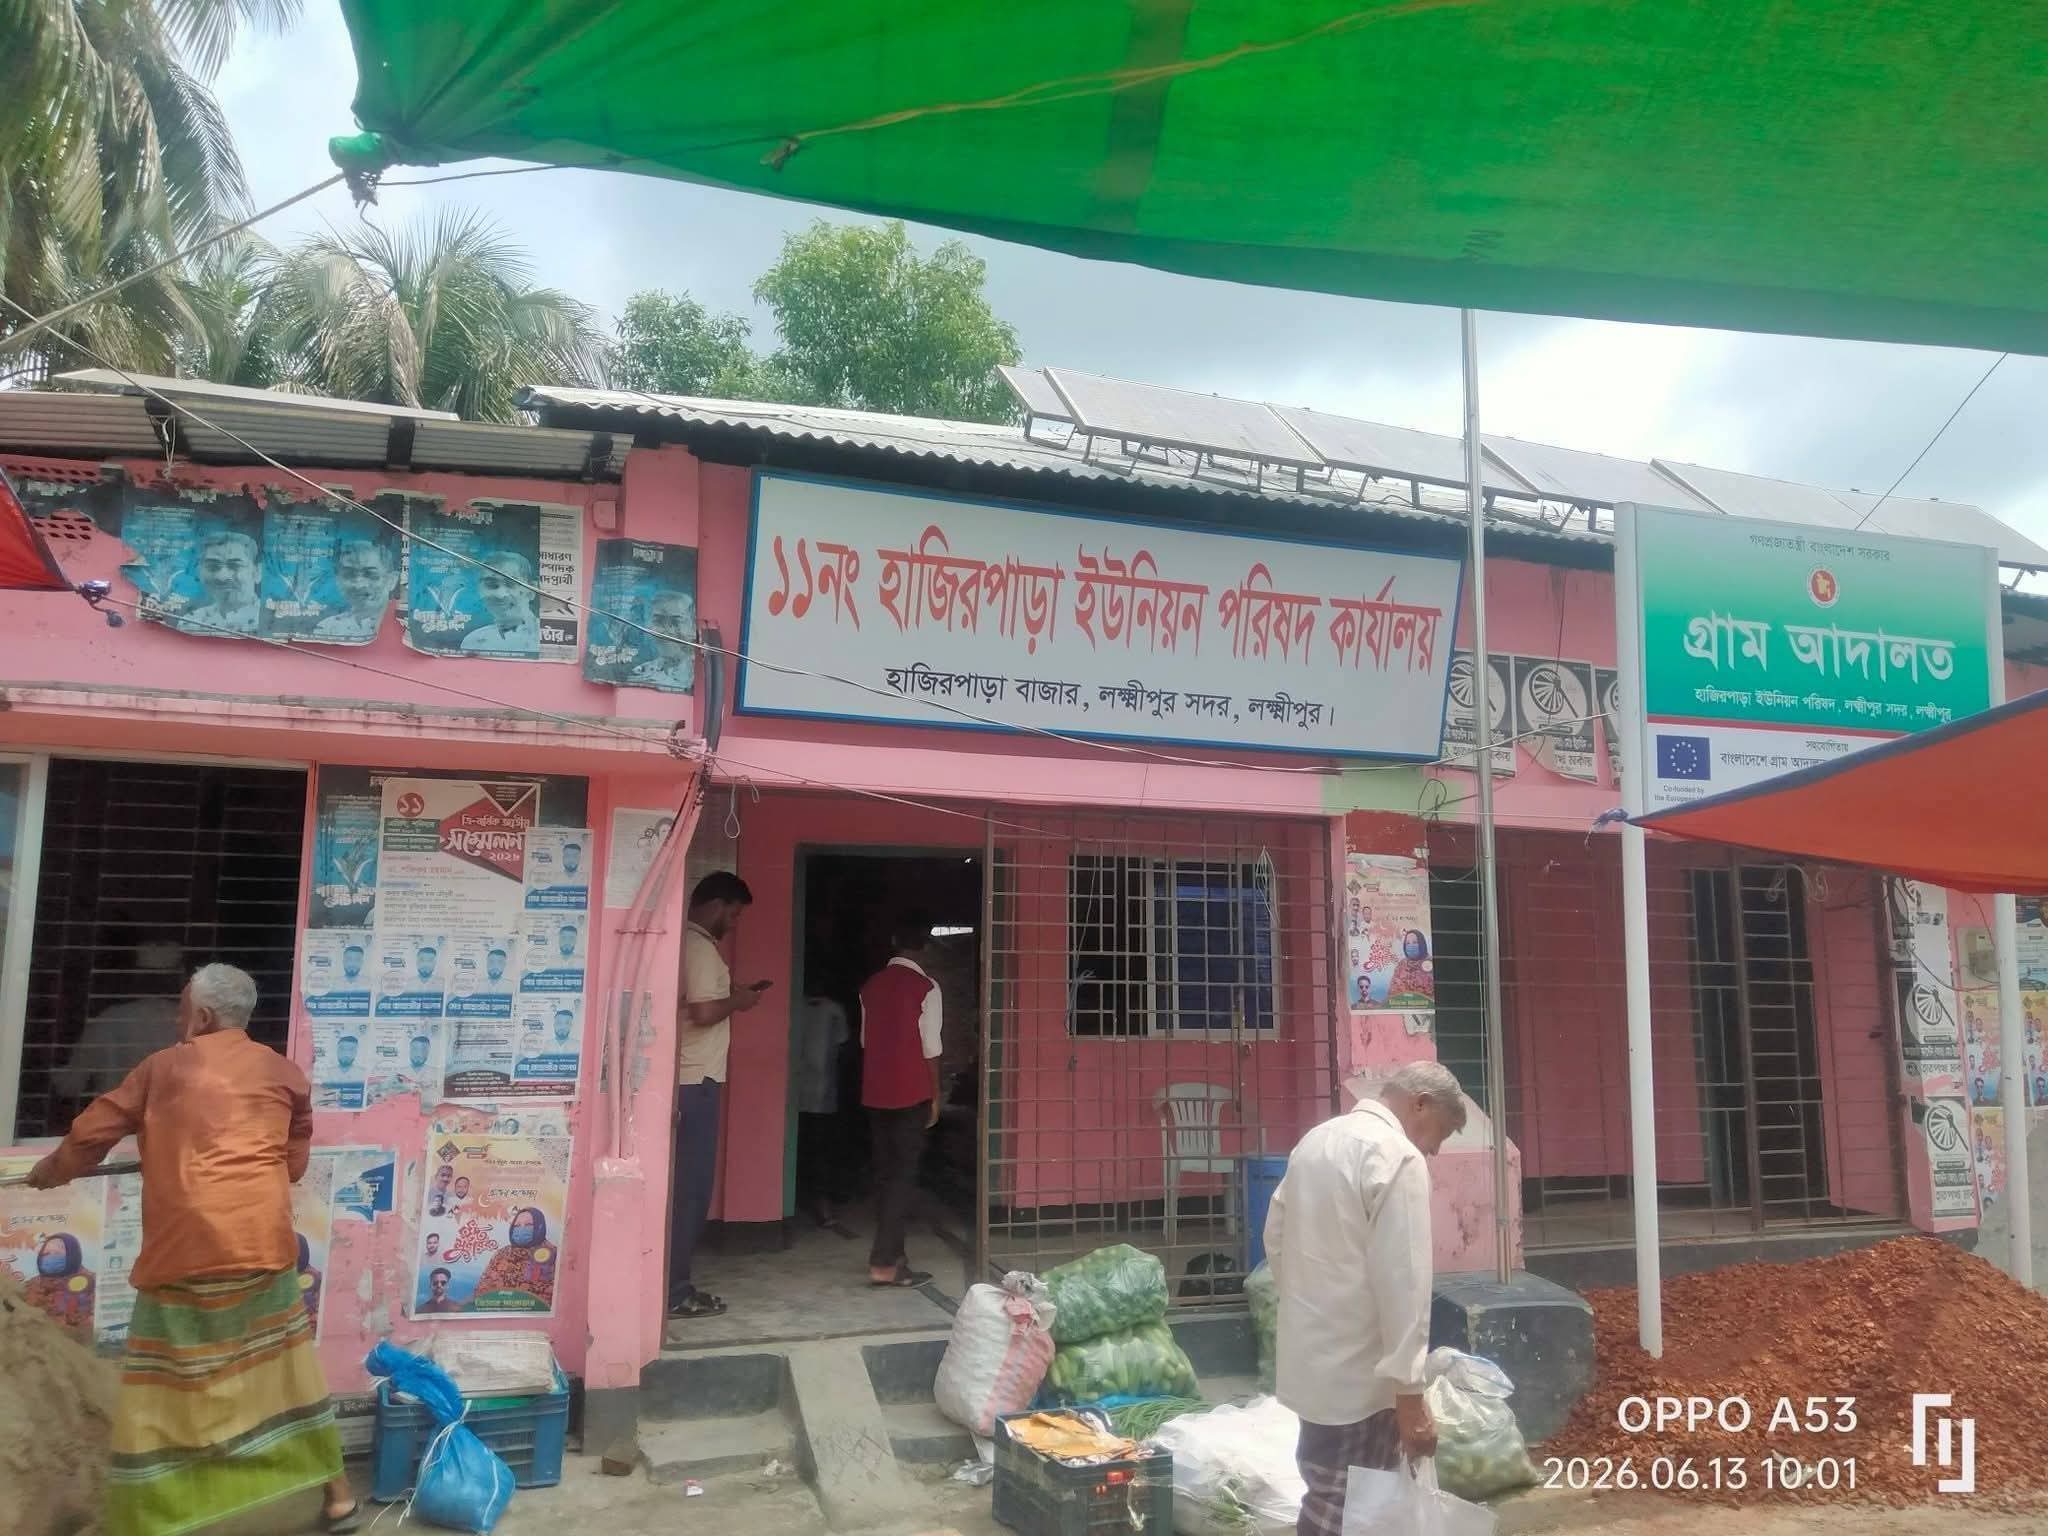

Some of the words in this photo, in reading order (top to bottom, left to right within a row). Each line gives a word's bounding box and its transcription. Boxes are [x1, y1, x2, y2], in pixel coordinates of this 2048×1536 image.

[1809, 541, 1854, 558] বাংলাদেশ
[1857, 547, 1892, 562] সরকার
[768, 535, 861, 632] ১১নং
[876, 525, 1066, 656] হাজিরপাড়া
[1074, 545, 1210, 656] ইউনিয়ন
[1218, 562, 1322, 663] পরিষদ
[1329, 576, 1444, 675] কার্যালয়
[1683, 609, 1773, 672] গ্রাম
[1783, 621, 1957, 684] আদালত
[885, 662, 1009, 704] হাজিরপাড়া
[1098, 679, 1180, 720] লক্ষ্মীপুর
[1754, 689, 1800, 709] ইউনিয়ন
